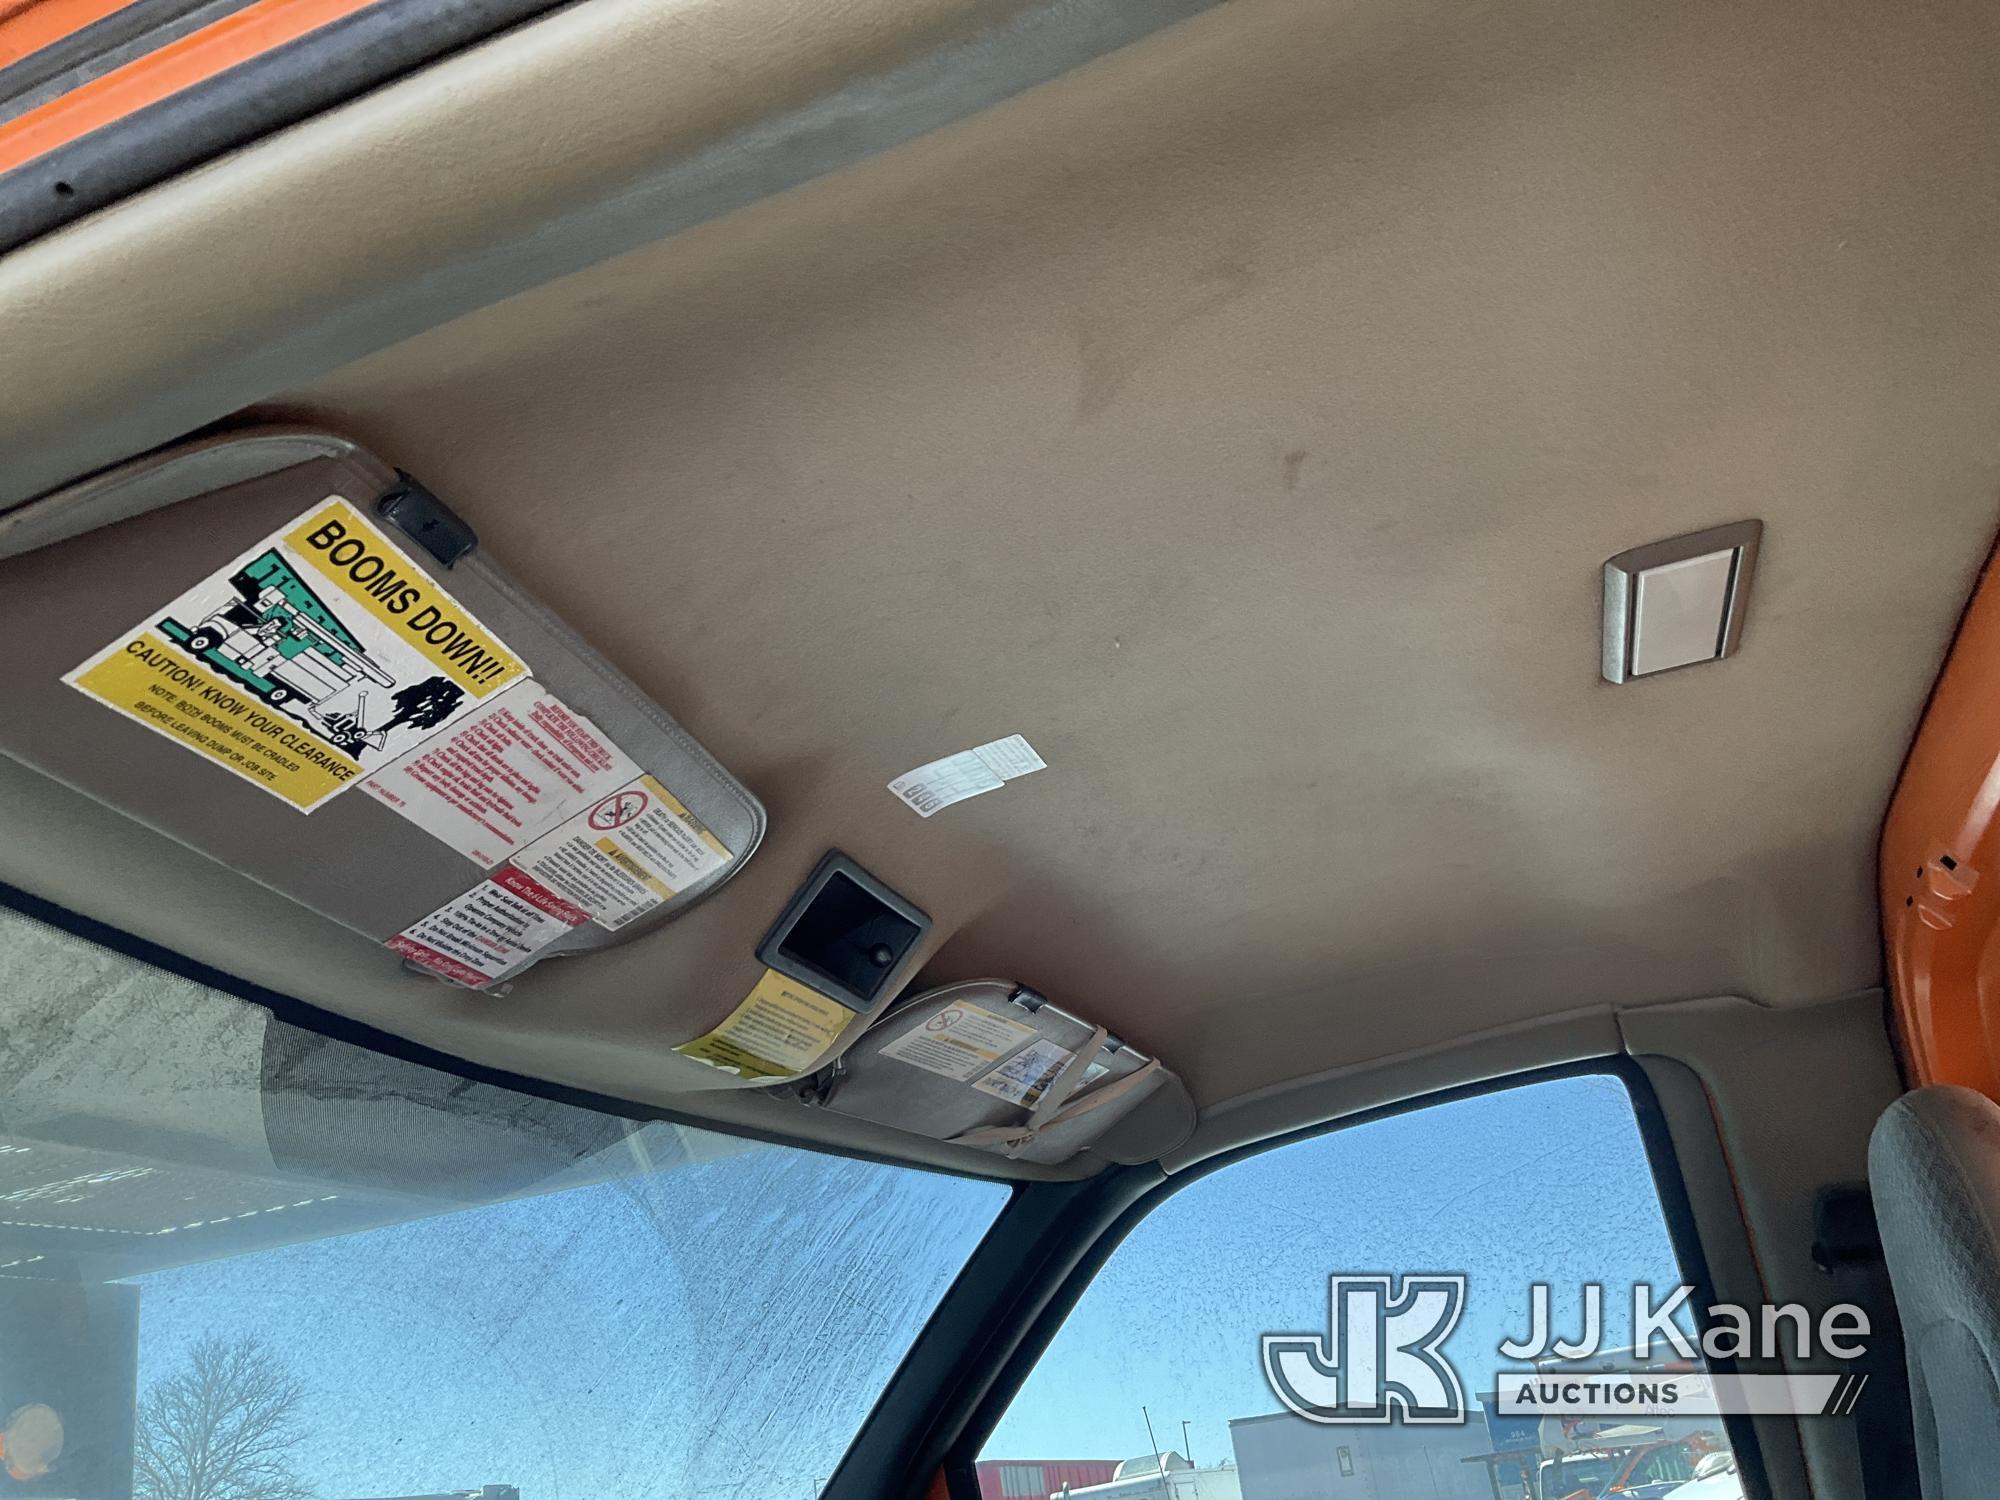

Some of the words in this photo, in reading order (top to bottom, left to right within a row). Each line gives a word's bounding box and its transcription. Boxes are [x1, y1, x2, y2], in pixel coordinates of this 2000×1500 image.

[306, 520, 419, 613] BOOMS
[407, 605, 504, 683] DOWN!!
[126, 640, 204, 691] CAUTION!
[198, 686, 248, 715] KNOW
[243, 711, 284, 738] YOUR
[279, 733, 354, 780] CLEARANCE
[133, 701, 174, 723] BEFORE
[169, 721, 209, 743] LEAVING
[205, 739, 232, 754] DUMP
[228, 752, 244, 762] OR
[240, 760, 260, 771] JOB
[256, 768, 276, 781] SITE
[174, 700, 203, 717] BOTH
[199, 713, 233, 733] BOOMS
[229, 729, 255, 745] MUST
[250, 742, 266, 752] BE
[262, 749, 300, 771] CRADLED
